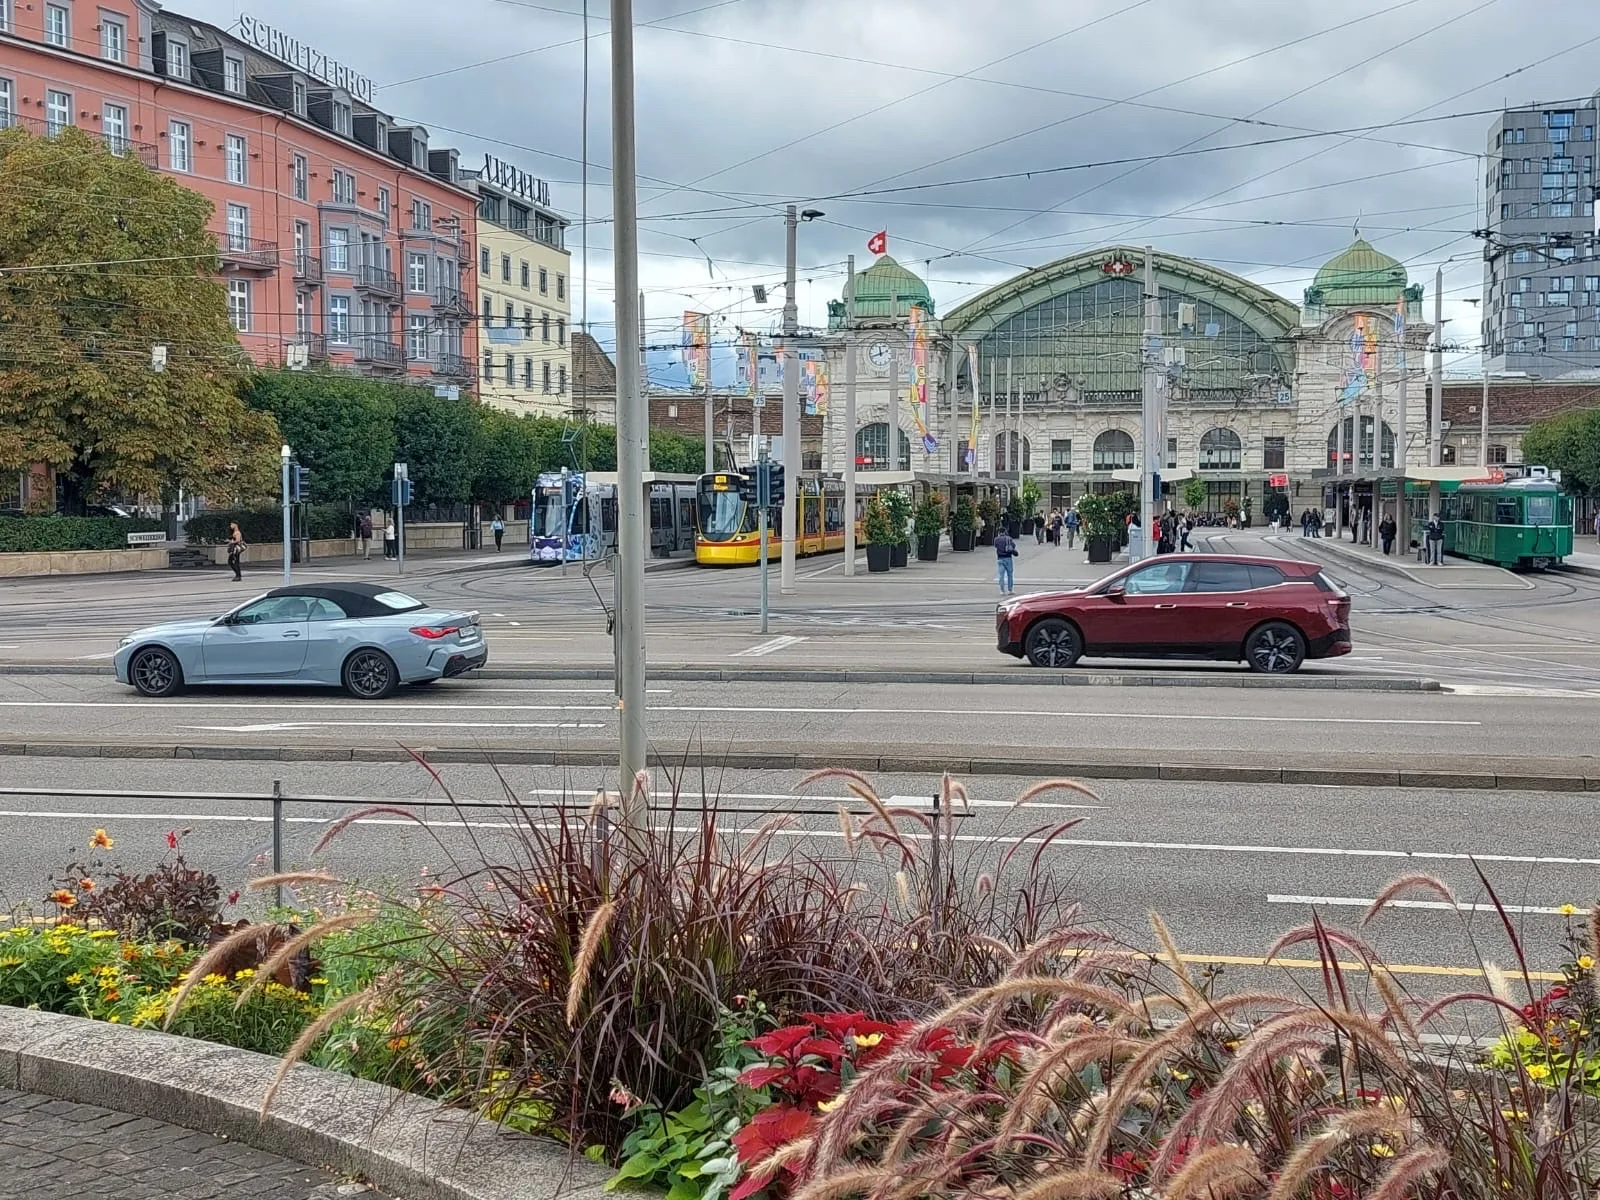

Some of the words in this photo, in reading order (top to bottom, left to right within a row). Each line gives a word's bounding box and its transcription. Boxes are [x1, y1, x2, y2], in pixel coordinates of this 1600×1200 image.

[240, 12, 377, 102] SCHWEIZERHOF
[755, 396, 765, 405] 25
[1279, 392, 1290, 402] 25
